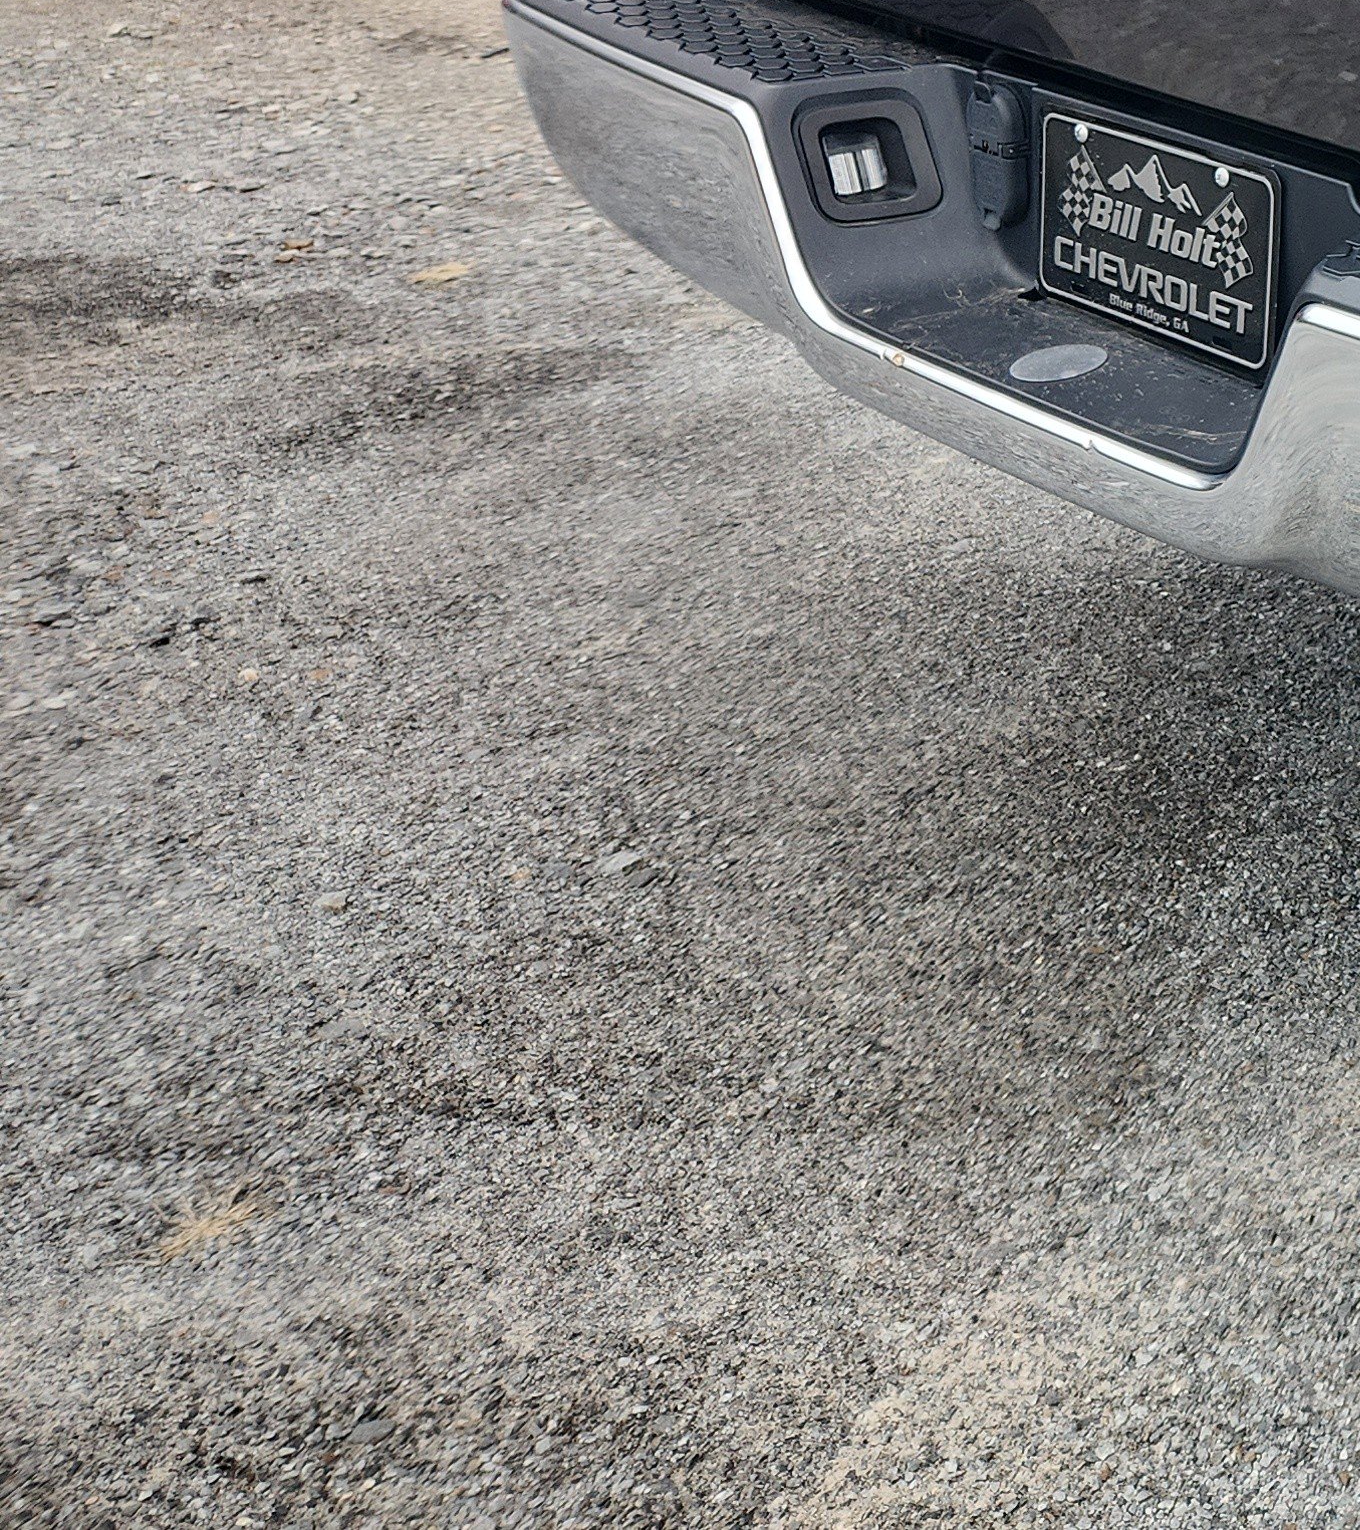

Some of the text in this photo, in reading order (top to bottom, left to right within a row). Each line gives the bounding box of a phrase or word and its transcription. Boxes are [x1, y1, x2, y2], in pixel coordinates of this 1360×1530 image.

[1088, 192, 1221, 268] Bill Holt
[1054, 235, 1253, 335] CHEVROLET
[1109, 293, 1189, 333] Blue Ridge, GA
